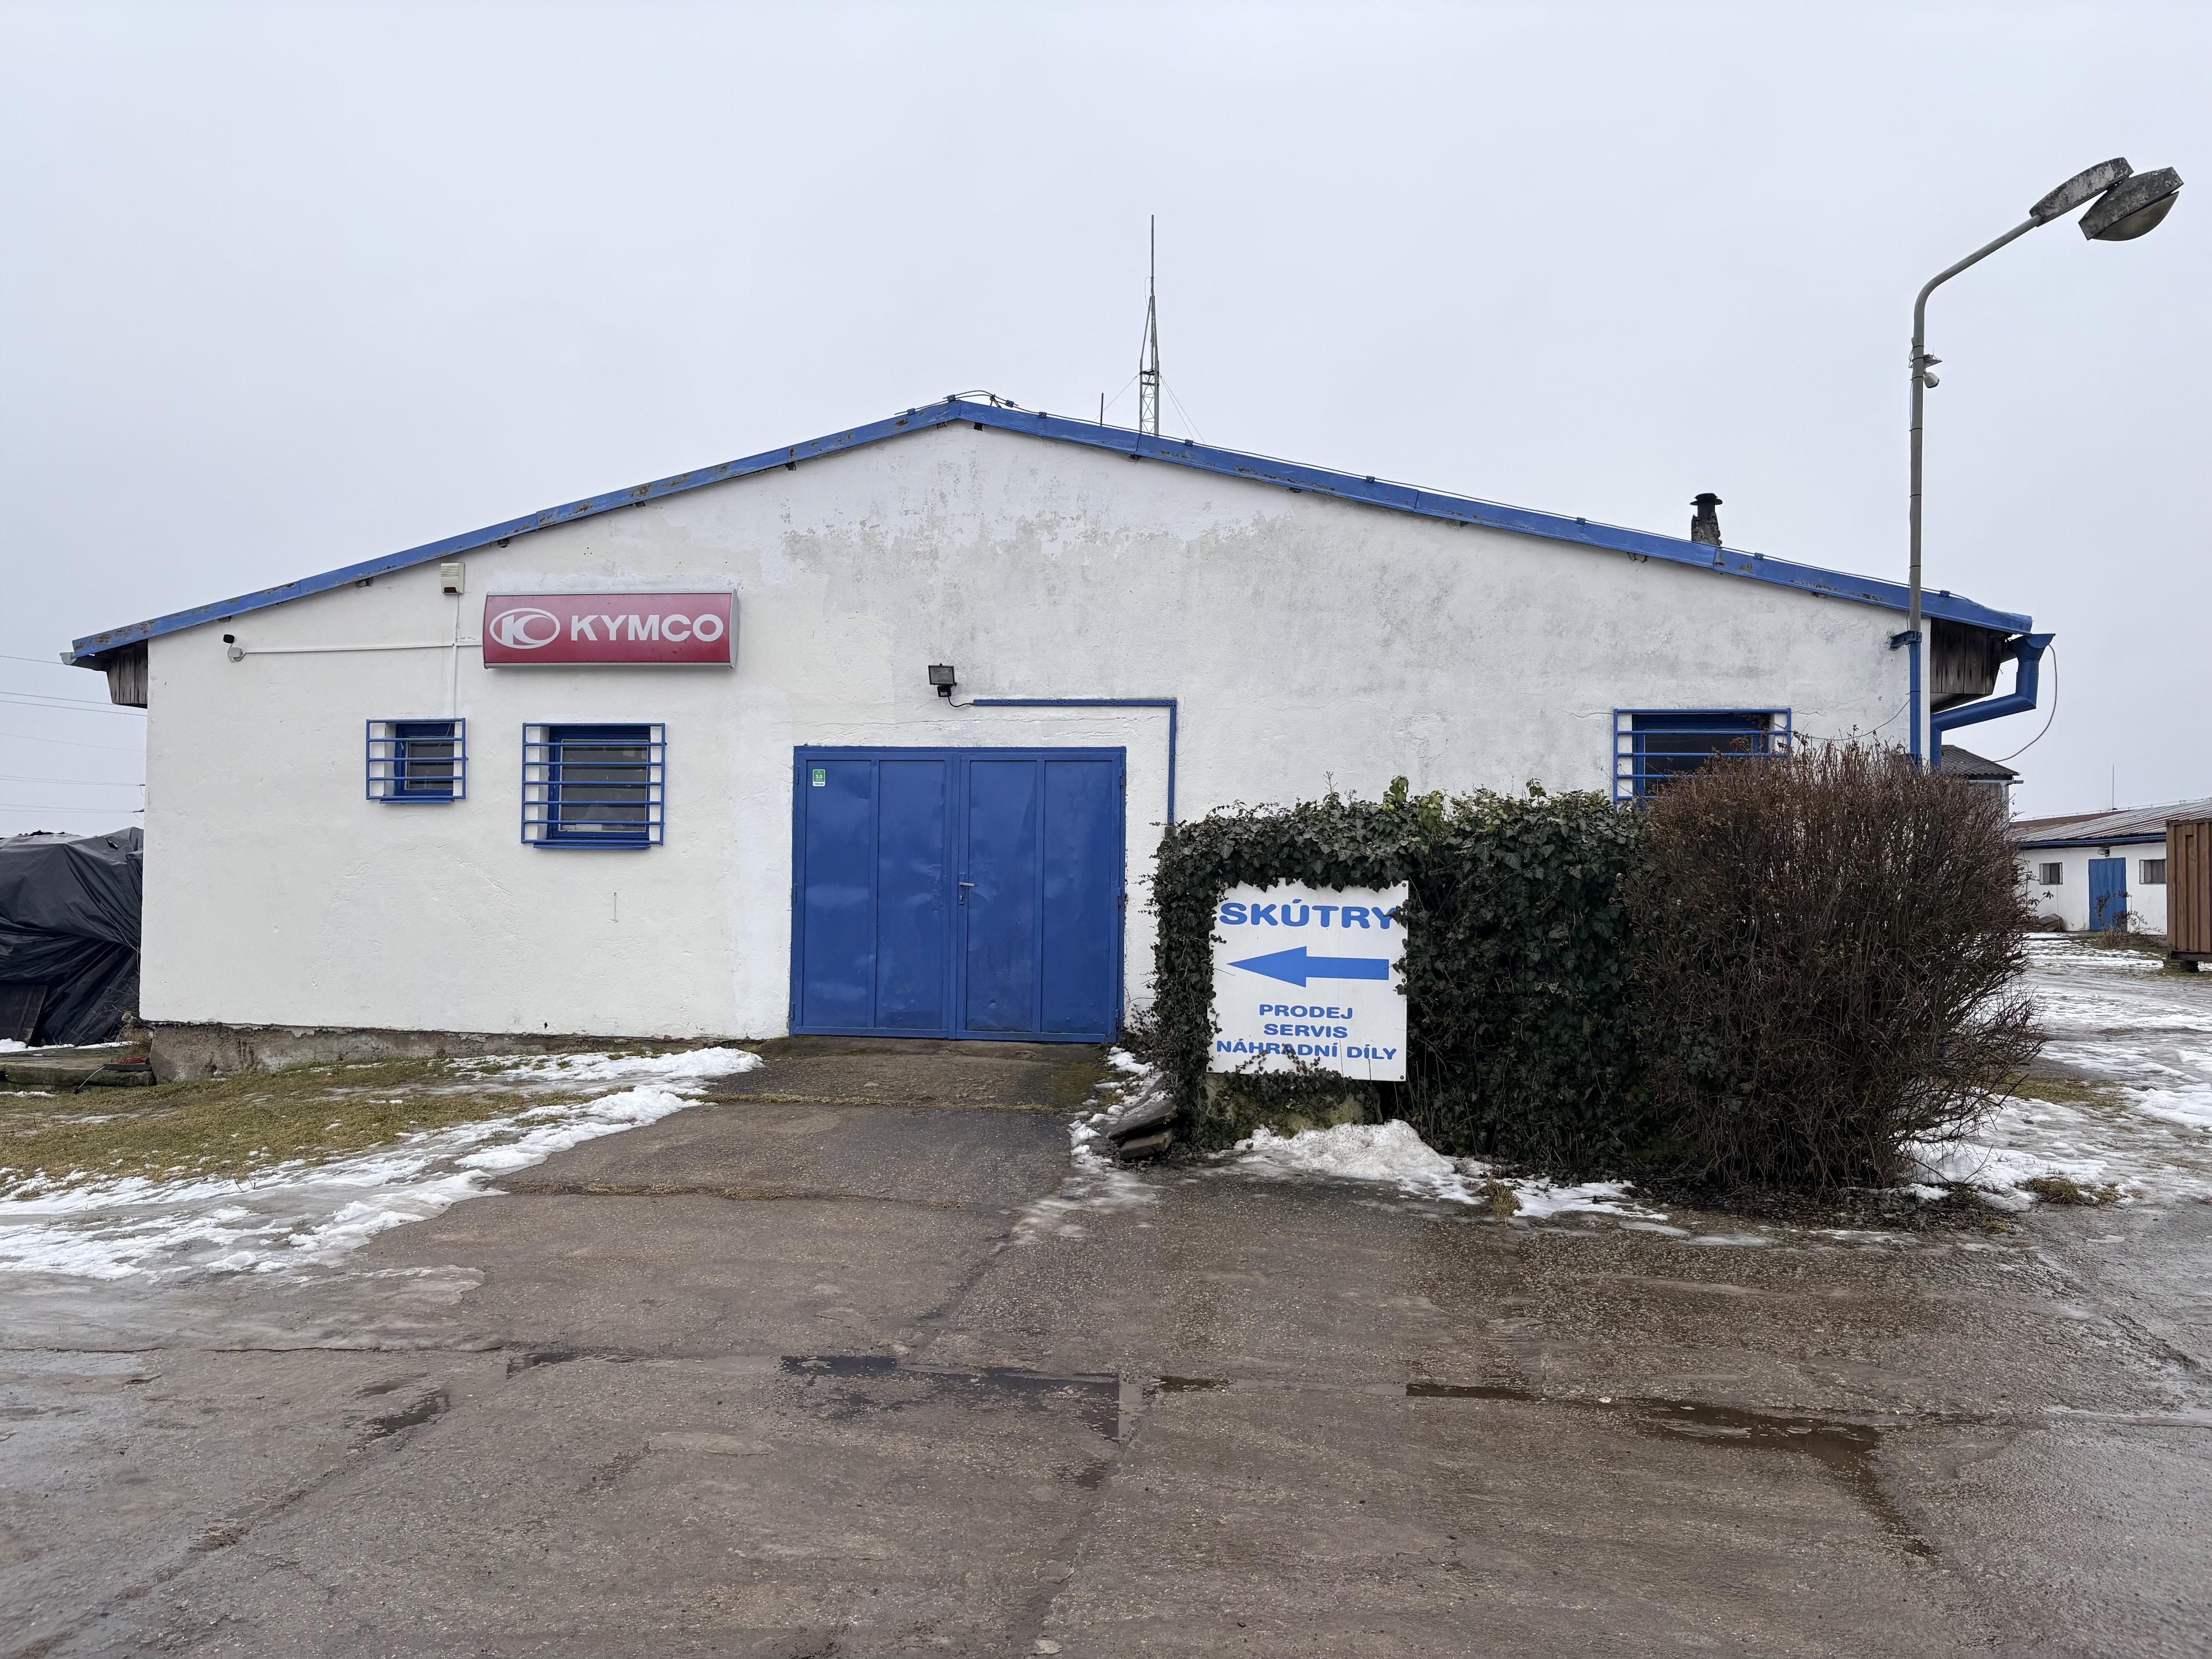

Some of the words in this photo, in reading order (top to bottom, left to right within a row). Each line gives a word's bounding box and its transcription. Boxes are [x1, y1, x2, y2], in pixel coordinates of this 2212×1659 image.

[571, 614, 724, 641] KYMCO
[1219, 899, 1397, 929] SKÚTRY
[1259, 1004, 1353, 1019] PRODEJ
[1264, 1023, 1348, 1039] SERVIS
[1217, 1038, 1338, 1057] NÁHRADNÍ
[1347, 1044, 1397, 1060] DÍLY
